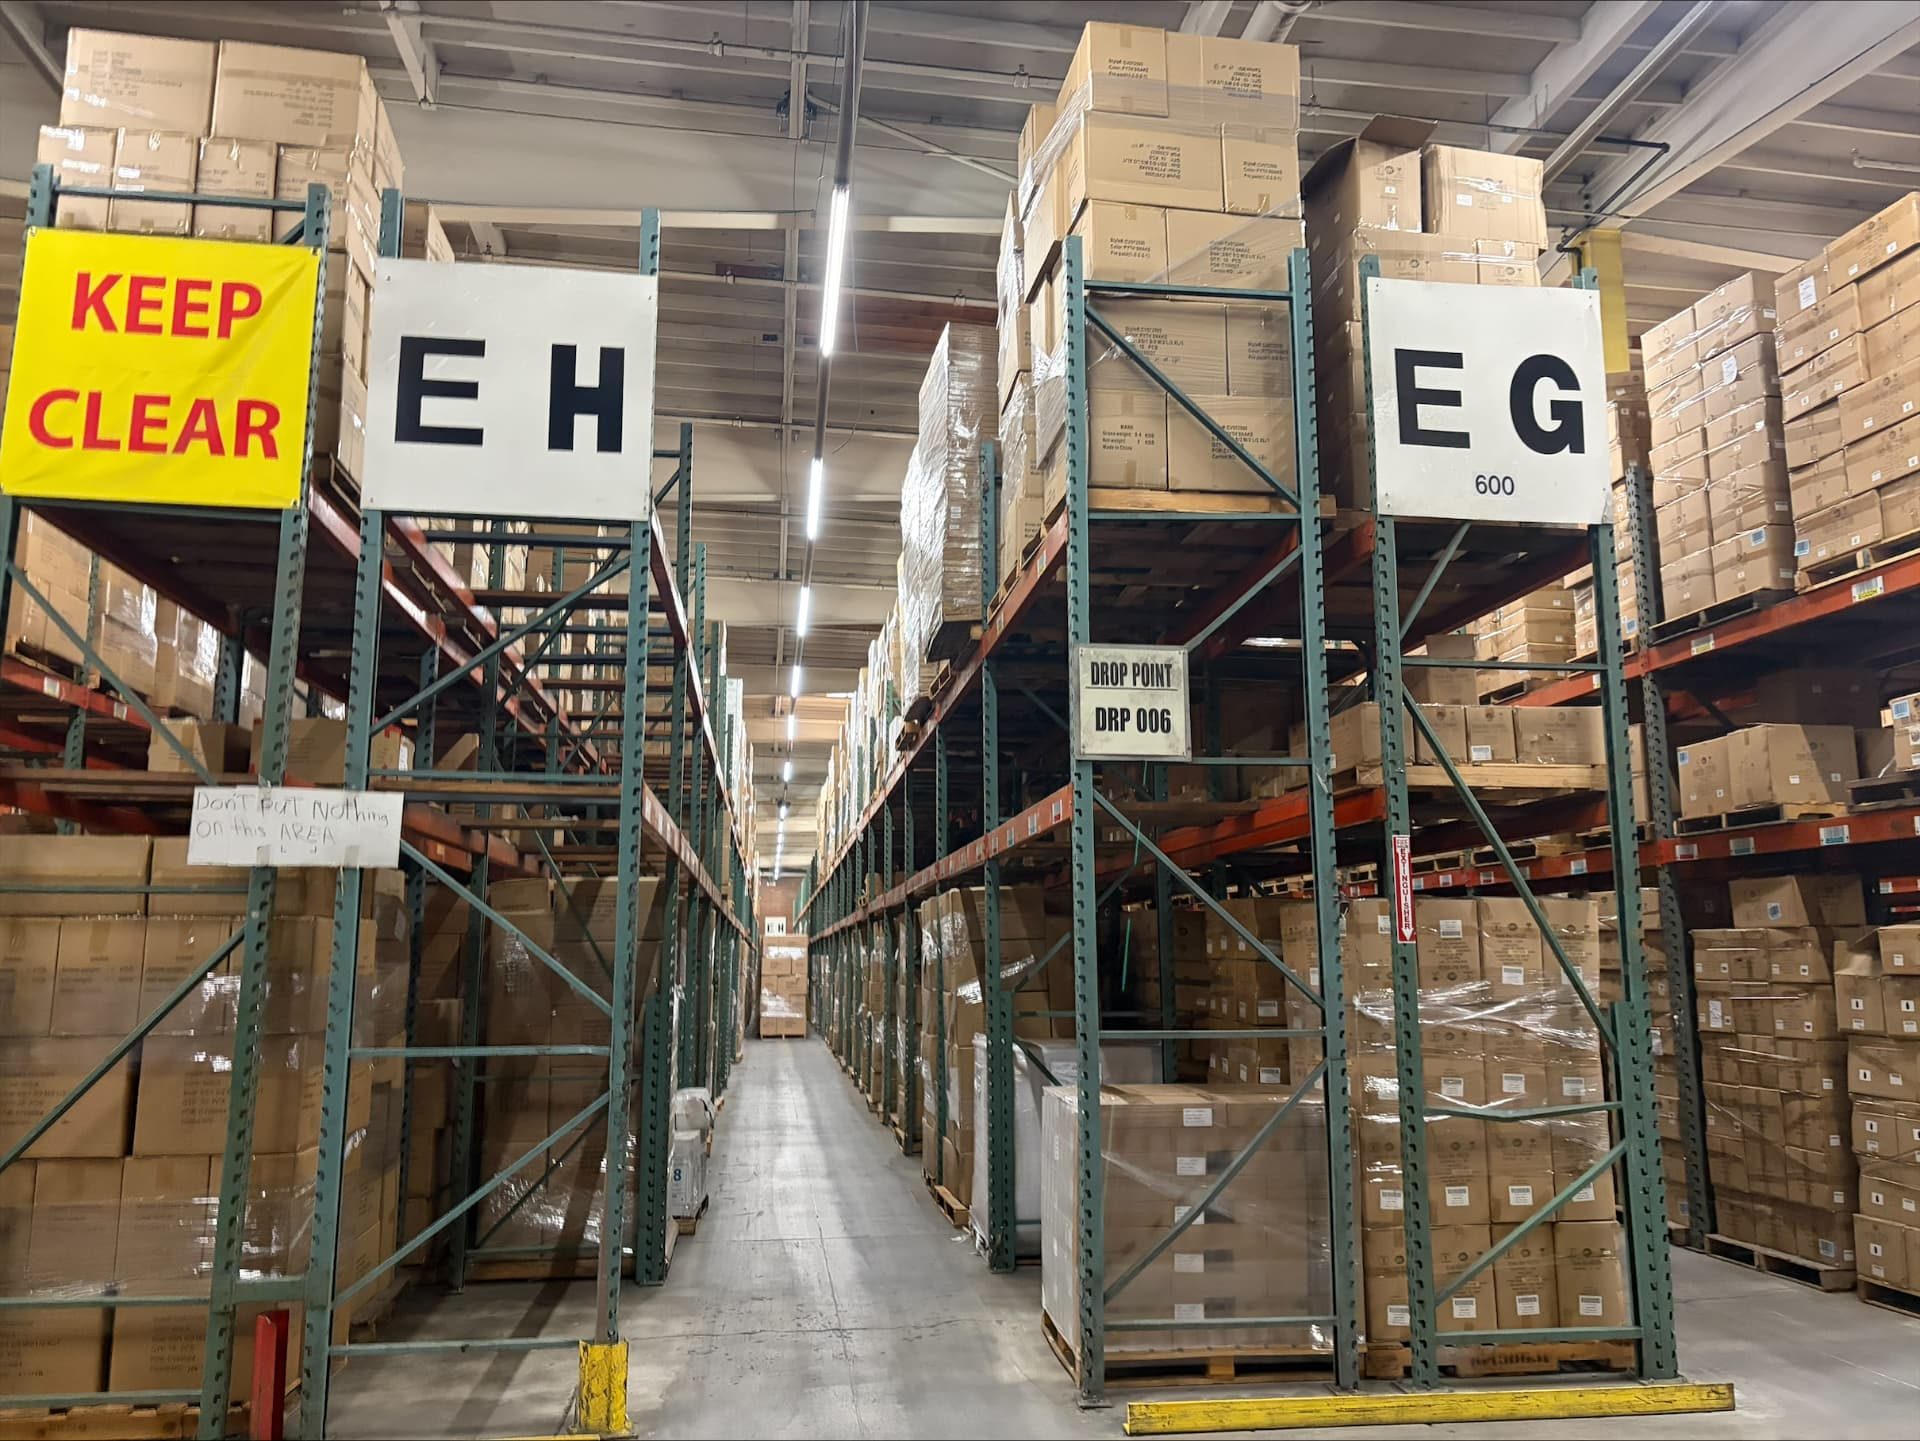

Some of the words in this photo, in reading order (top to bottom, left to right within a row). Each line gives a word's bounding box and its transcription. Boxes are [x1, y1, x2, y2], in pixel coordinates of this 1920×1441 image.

[71, 271, 263, 340] KEEP
[28, 388, 281, 460] CLEAR
[1475, 474, 1515, 496] 600
[1091, 662, 1128, 686] DROP
[1132, 662, 1172, 688] POINT
[1095, 707, 1131, 732] DRP
[1136, 707, 1172, 734] 006
[280, 822, 336, 845] AREA
[673, 1168, 682, 1182] 8
